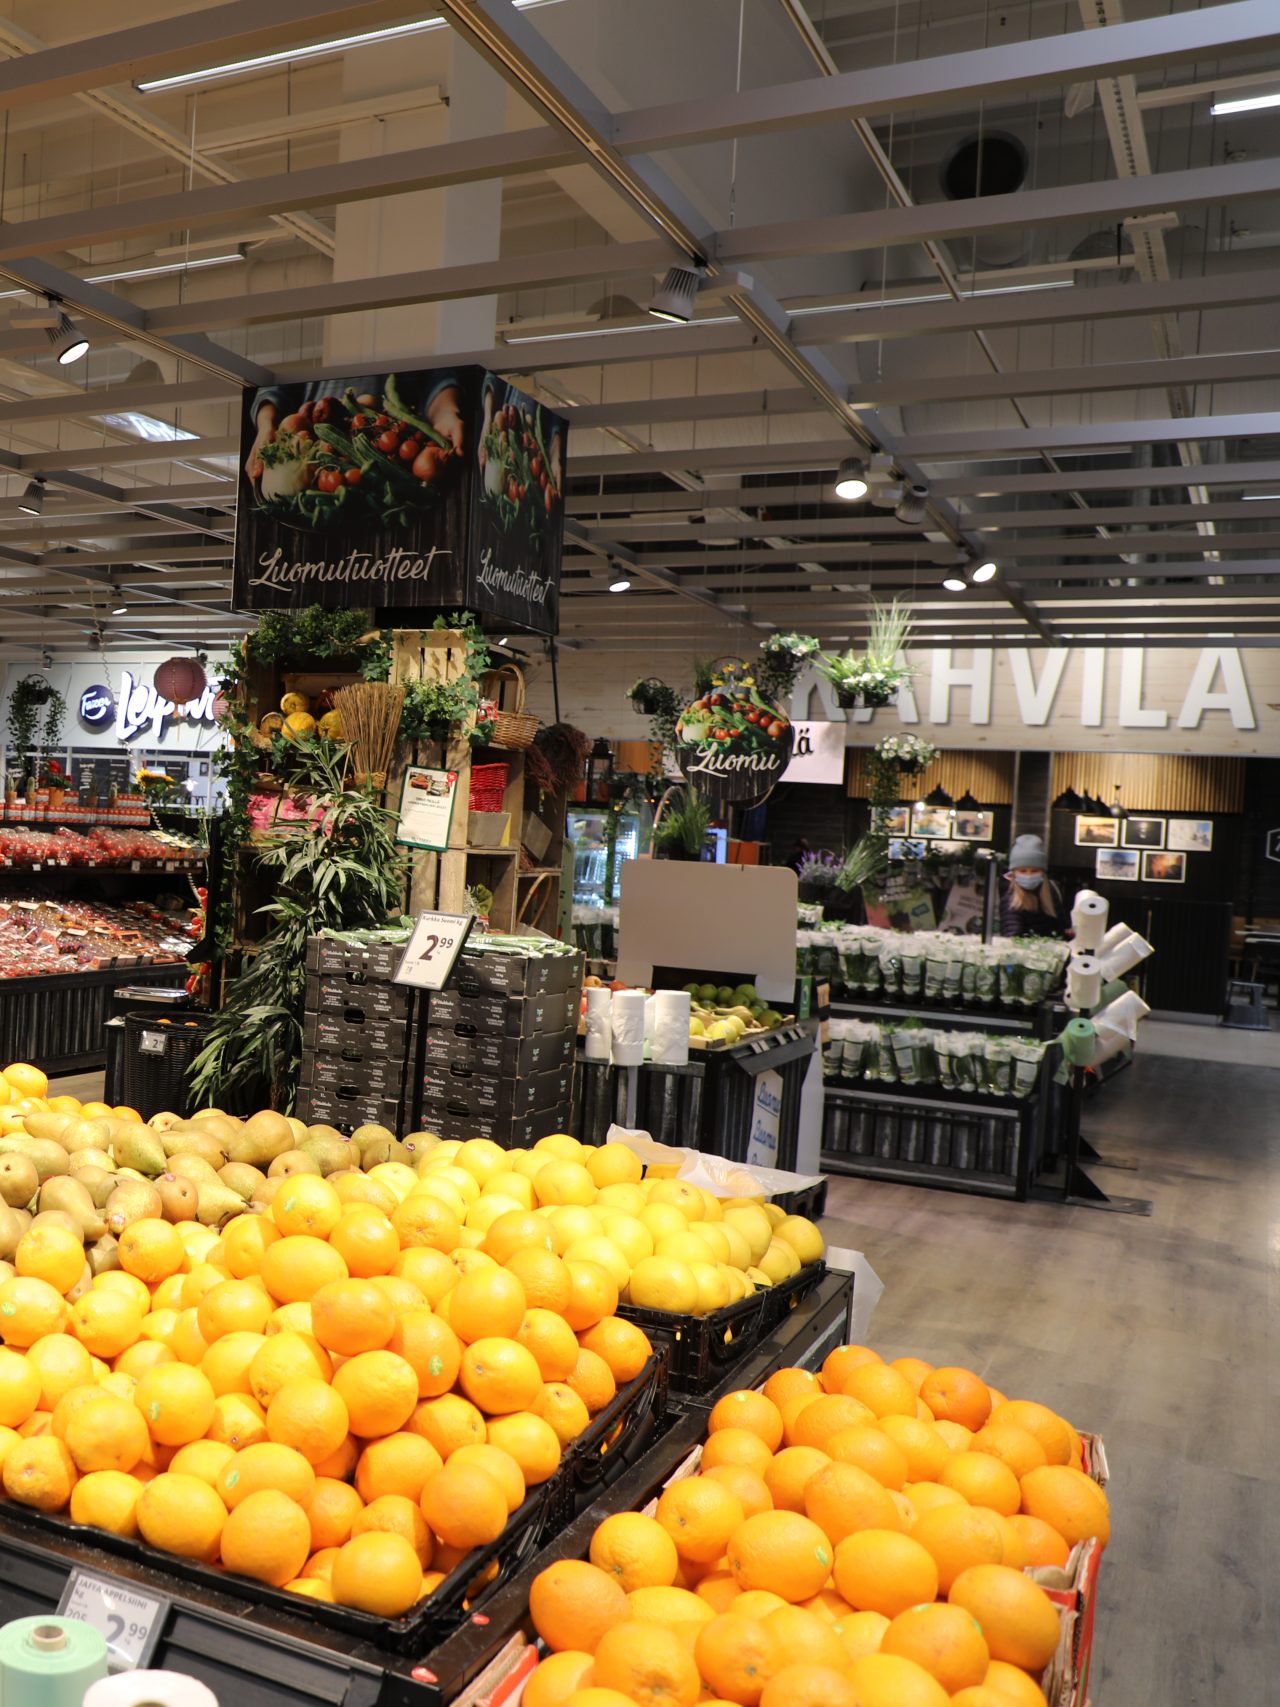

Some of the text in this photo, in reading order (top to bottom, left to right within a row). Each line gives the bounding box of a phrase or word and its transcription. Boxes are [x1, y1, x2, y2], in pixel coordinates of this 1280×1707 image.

[248, 545, 453, 592] Luomutuotteet
[686, 742, 781, 778] Luomu
[418, 934, 454, 961] 2 99
[78, 1578, 102, 1593] JAFFA
[104, 1588, 148, 1610] APPELSIINI
[106, 1613, 148, 1655] 2 99
